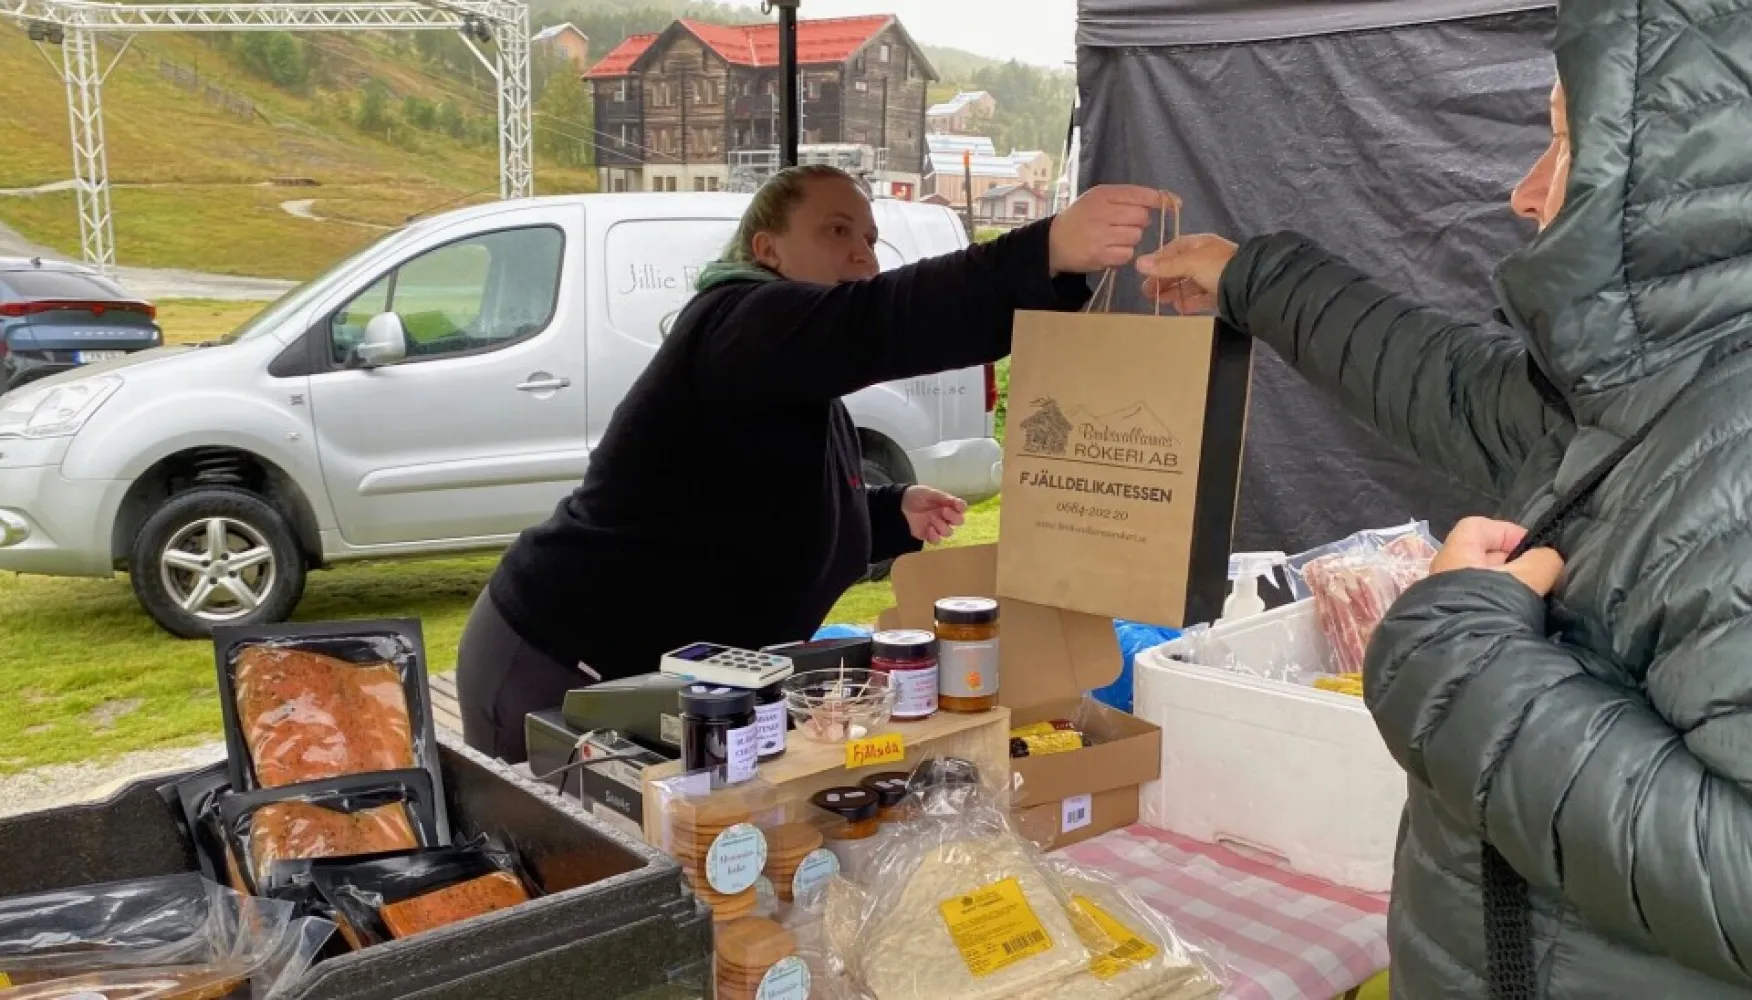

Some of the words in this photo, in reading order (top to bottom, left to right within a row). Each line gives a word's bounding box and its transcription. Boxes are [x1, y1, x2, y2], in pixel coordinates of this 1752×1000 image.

[619, 263, 676, 294] Jillie
[1074, 442, 1144, 464] RÖKERI
[1149, 451, 1178, 467] AB
[1019, 469, 1173, 504] FJÄLLDELIKATESSEN
[1056, 501, 1110, 519] 0684-202
[1112, 510, 1129, 521] 20
